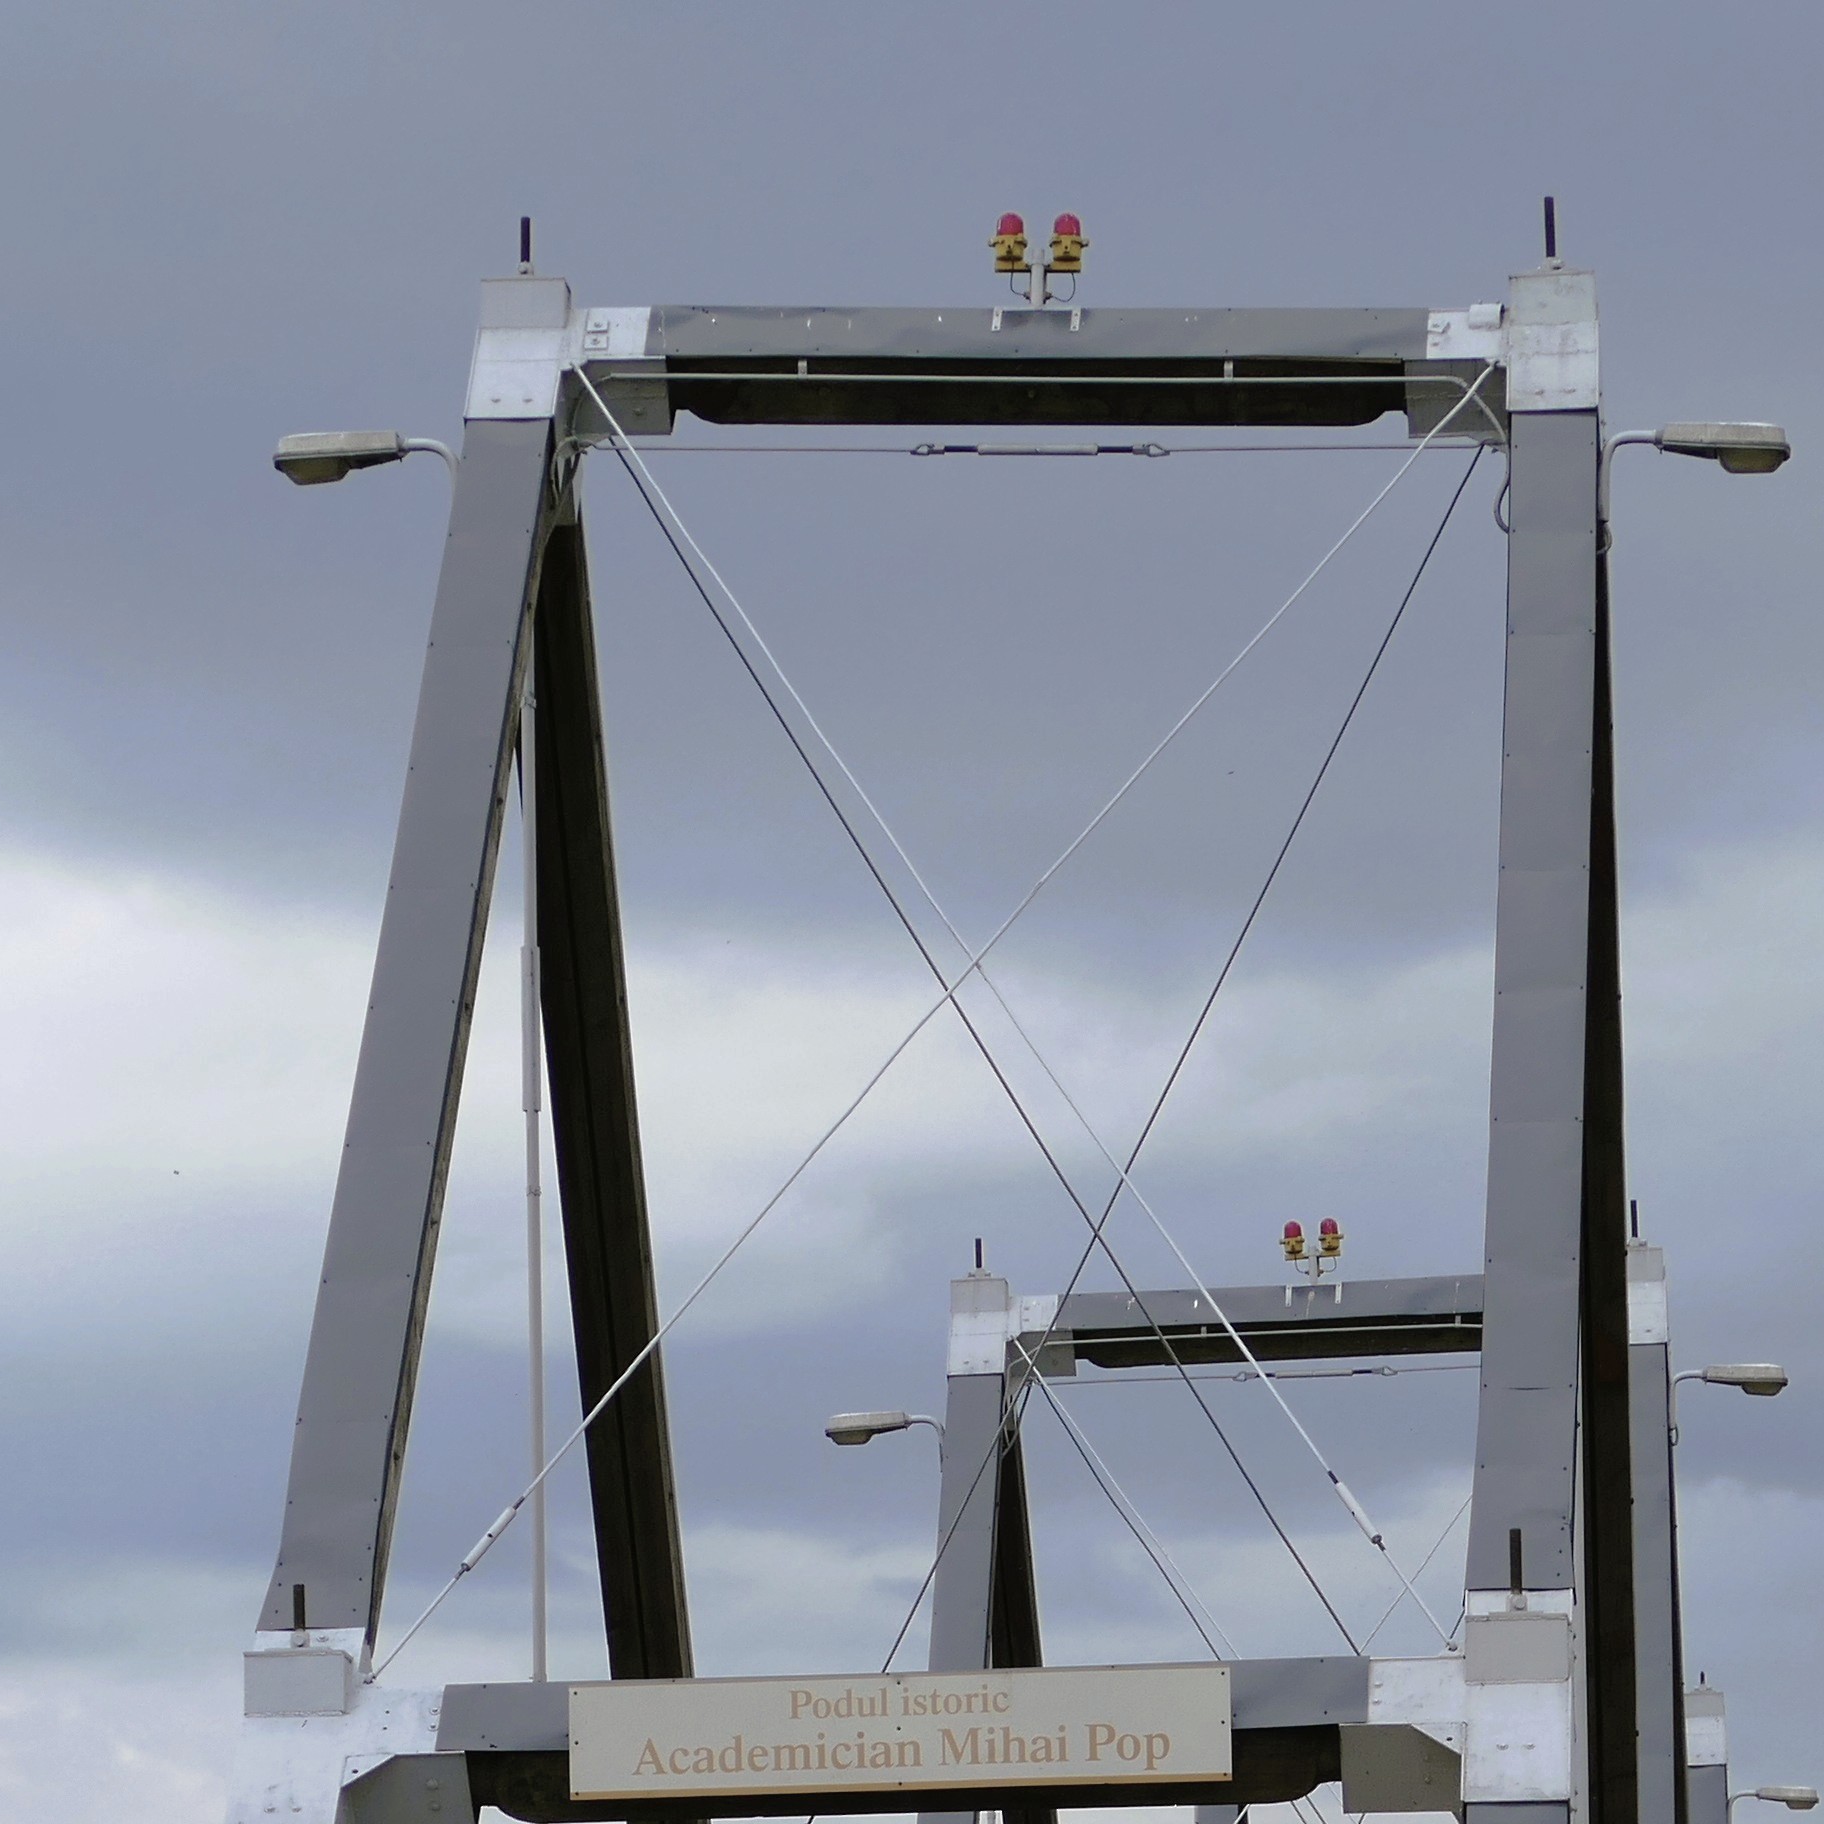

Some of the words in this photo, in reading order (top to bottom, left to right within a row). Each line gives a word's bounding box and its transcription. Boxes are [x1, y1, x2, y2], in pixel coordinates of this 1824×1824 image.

[789, 1687, 889, 1722] Podul
[900, 1684, 1010, 1717] istoric
[631, 1730, 922, 1777] Academician
[938, 1725, 1069, 1767] Mihai
[1084, 1723, 1171, 1771] Pop
